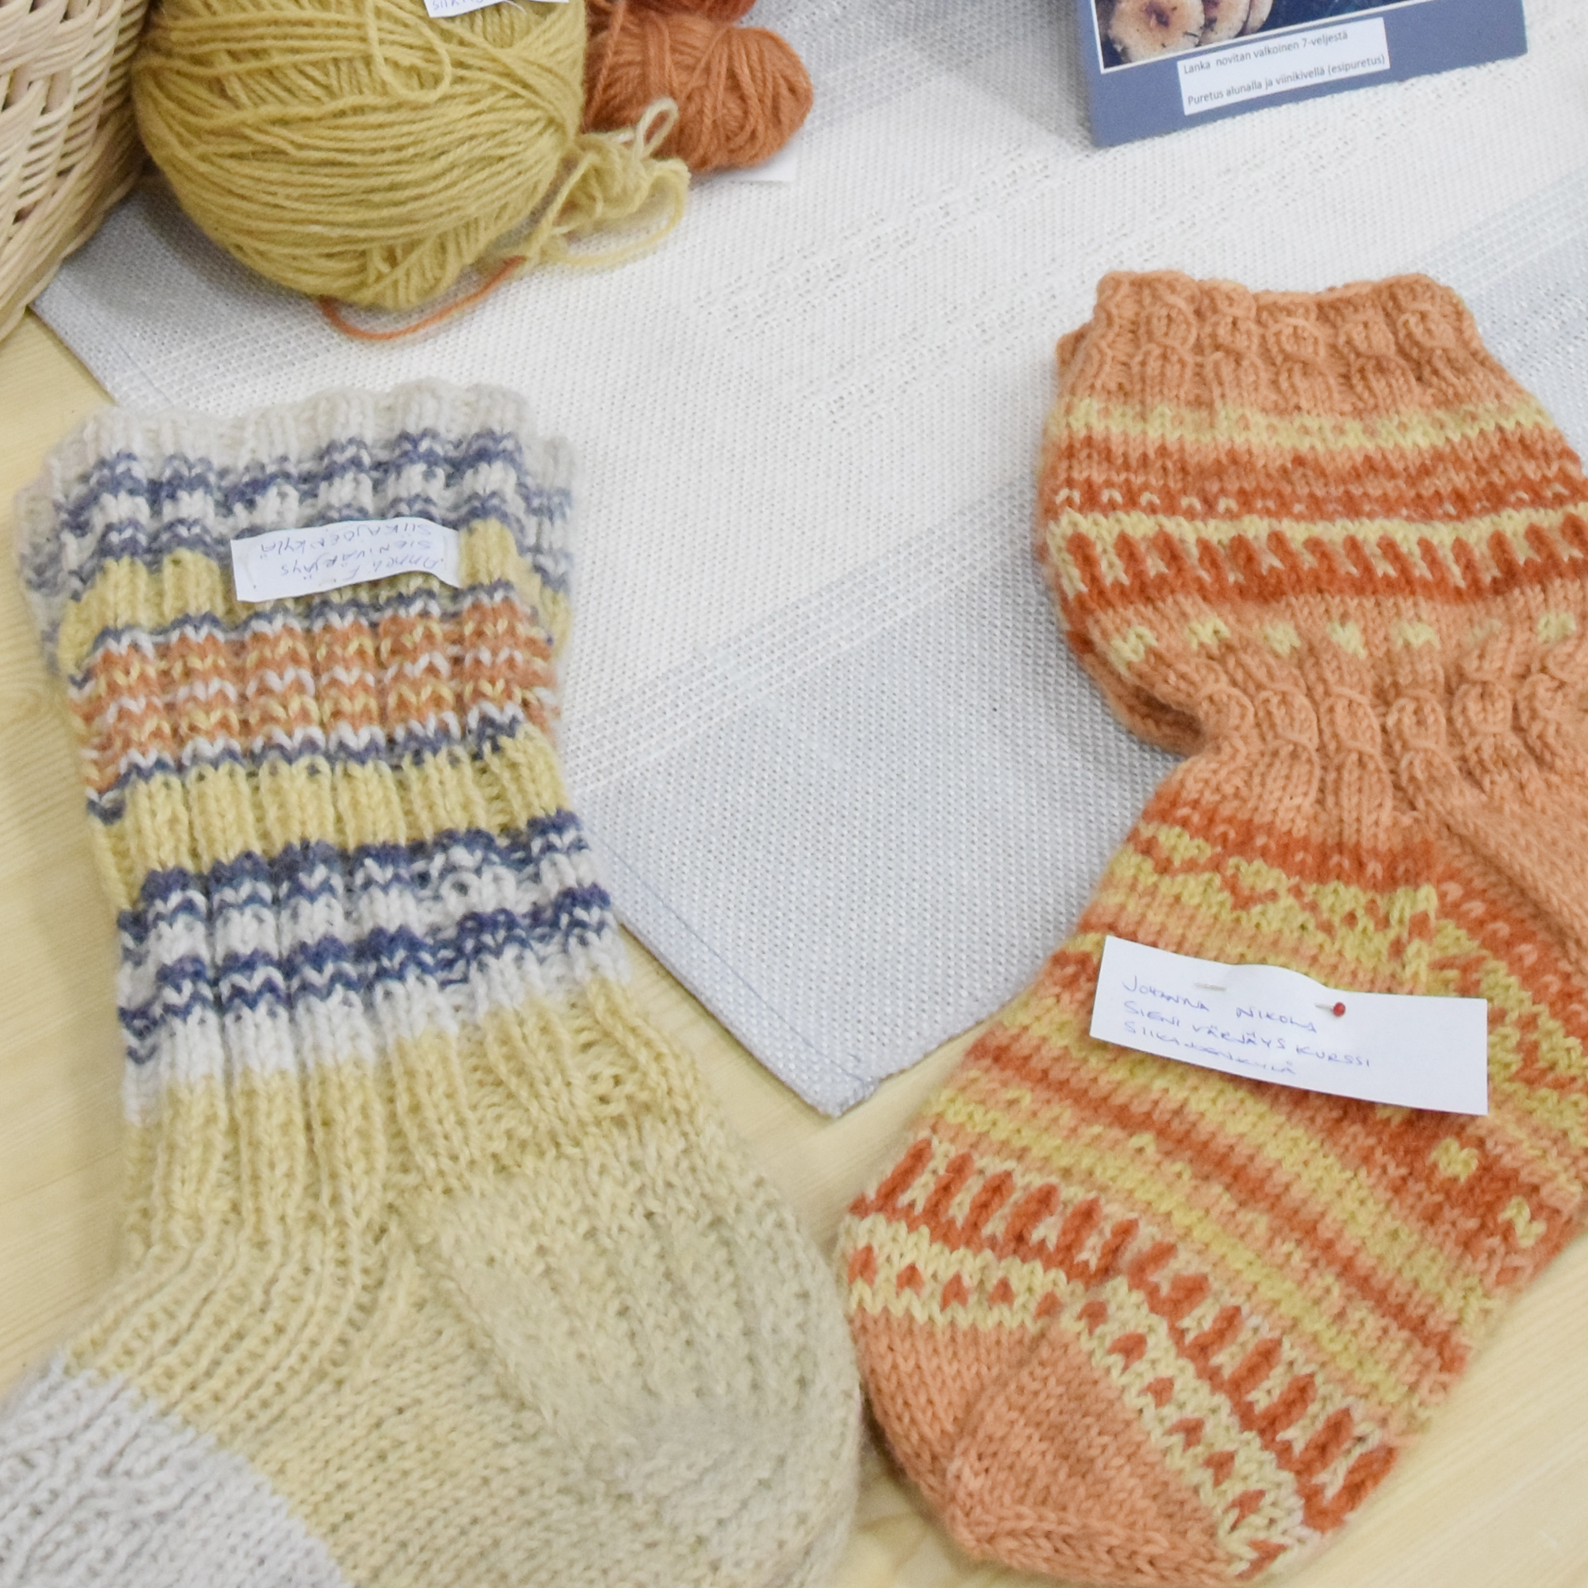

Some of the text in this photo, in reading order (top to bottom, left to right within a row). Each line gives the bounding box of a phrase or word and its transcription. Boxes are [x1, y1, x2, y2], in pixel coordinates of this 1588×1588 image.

[1183, 30, 1349, 75] Lanka novitan valkoinen 7-veljestä
[1187, 53, 1386, 107] Puretus alunalla ja viinikivellä (esipuretus)
